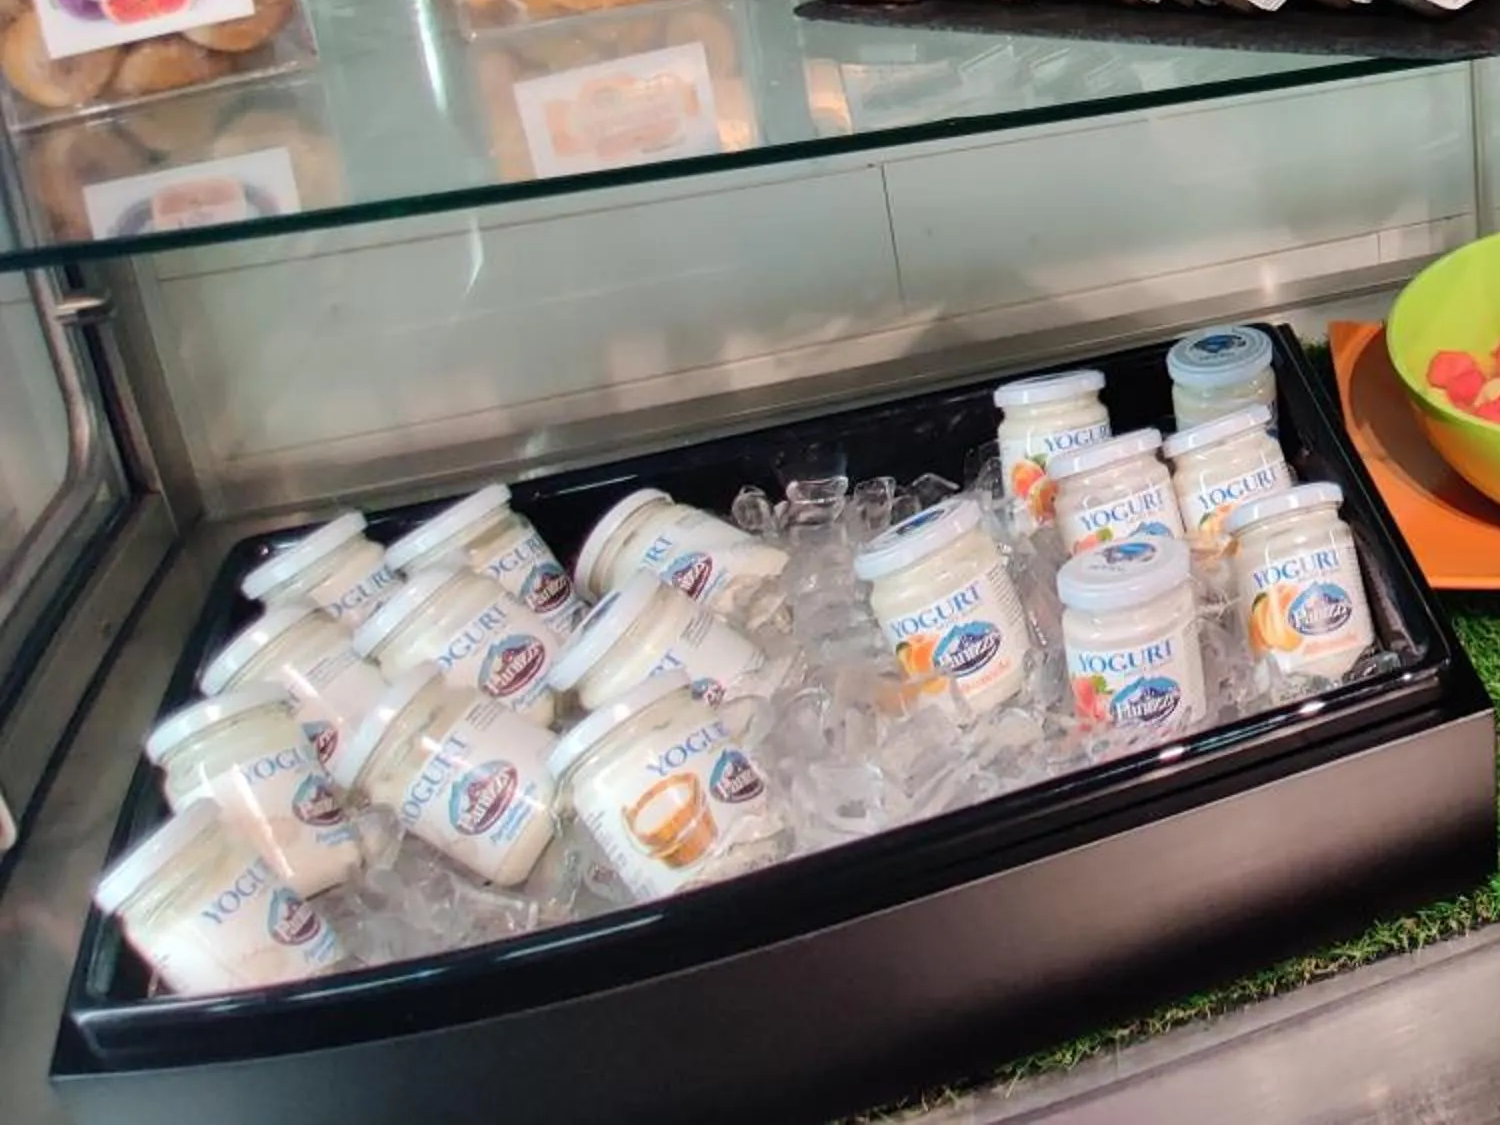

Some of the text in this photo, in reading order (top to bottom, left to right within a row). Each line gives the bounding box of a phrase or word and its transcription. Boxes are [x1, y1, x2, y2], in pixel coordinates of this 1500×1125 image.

[1080, 488, 1164, 531] YOGURT
[1198, 467, 1277, 510] YOGURT
[1253, 549, 1339, 588] YOGURT
[890, 580, 981, 638] YOGURT
[1078, 638, 1172, 673] YOGURT
